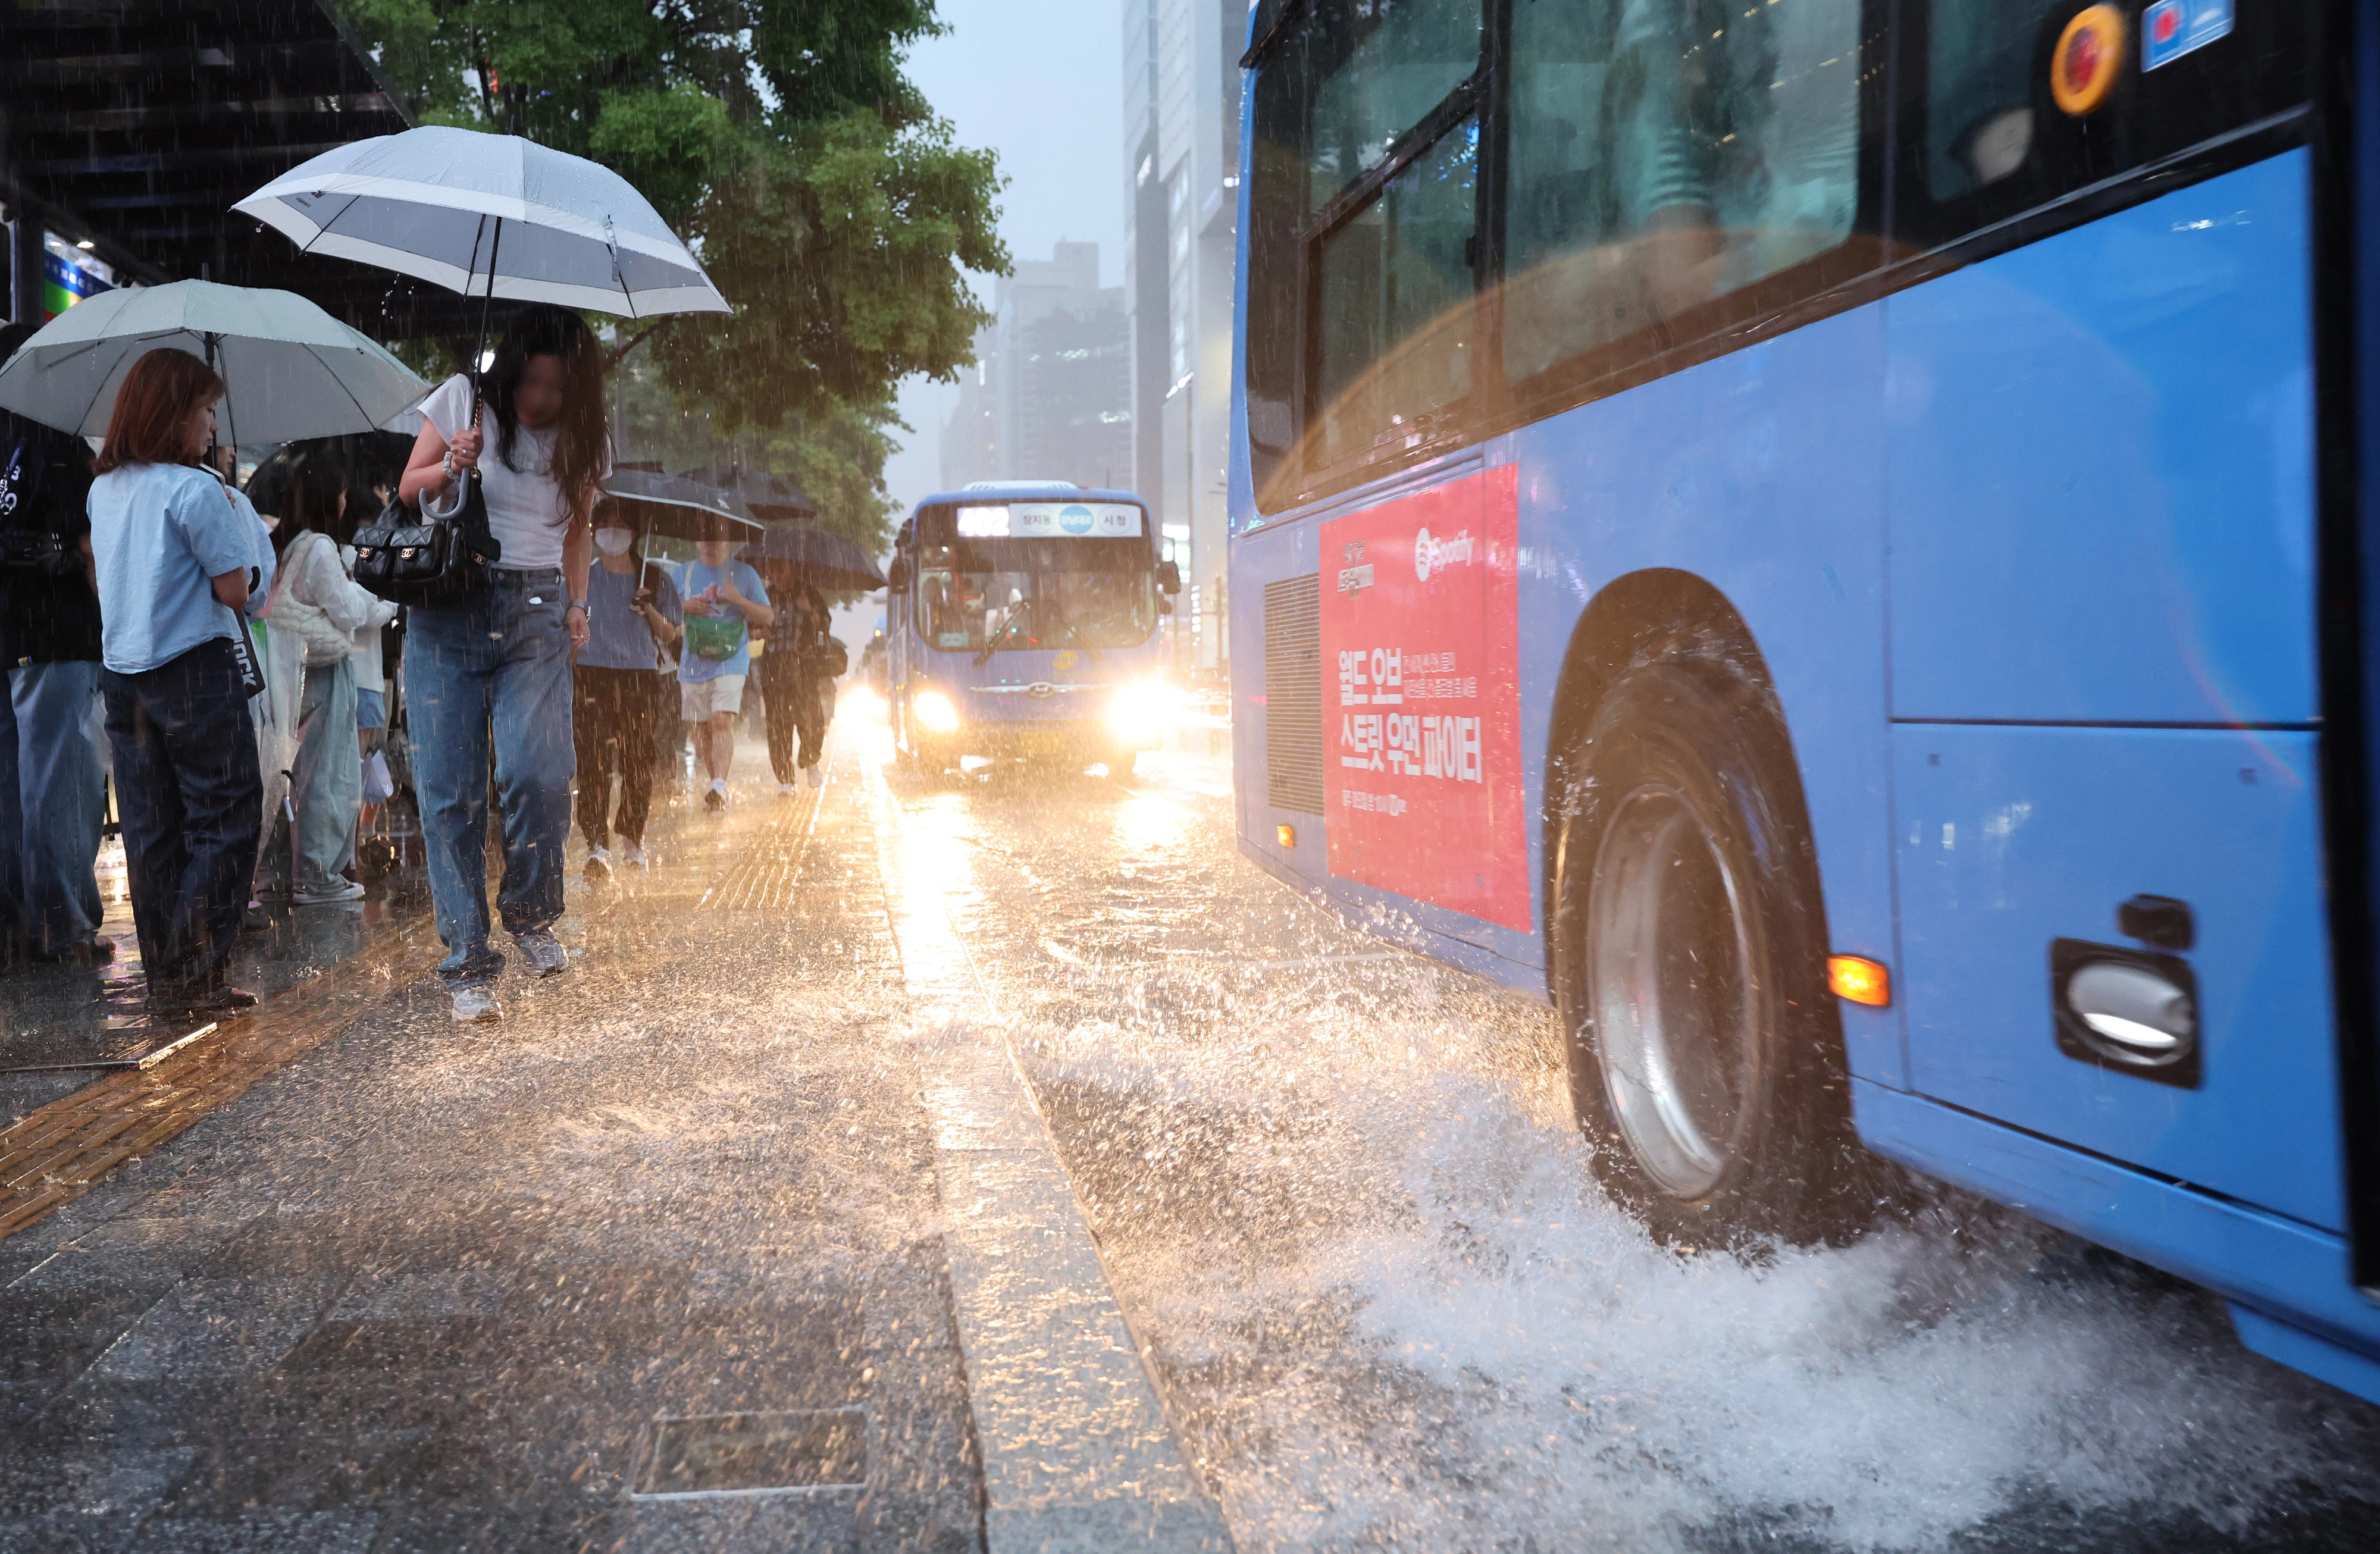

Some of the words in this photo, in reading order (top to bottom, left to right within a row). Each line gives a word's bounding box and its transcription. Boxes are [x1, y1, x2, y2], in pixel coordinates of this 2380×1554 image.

[957, 507, 1010, 537] 402
[1022, 514, 1052, 526] 장지동
[1430, 529, 1475, 571] Spotify
[233, 638, 256, 686] OCK
[1338, 650, 1368, 706] 월드
[1370, 647, 1403, 704] 오브
[1340, 713, 1386, 773] 스트릿
[1386, 712, 1422, 776] 우먼
[1422, 715, 1483, 784] 파이터
